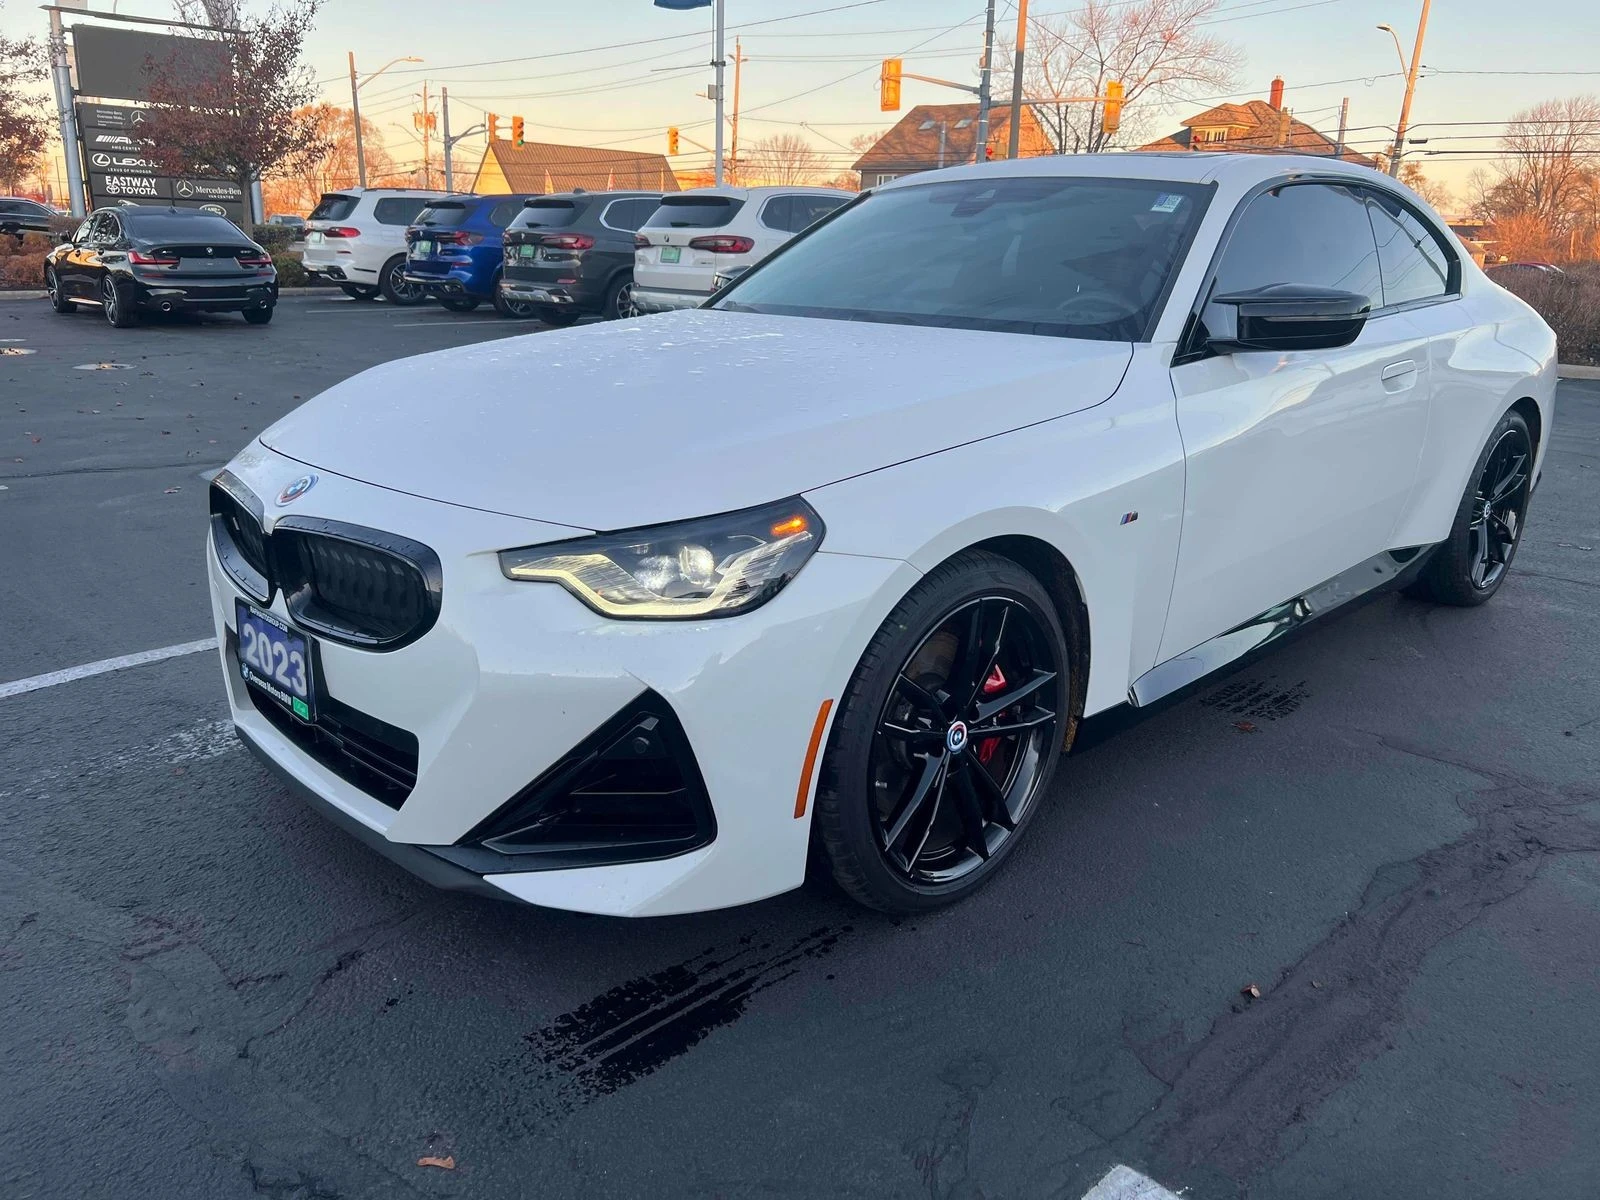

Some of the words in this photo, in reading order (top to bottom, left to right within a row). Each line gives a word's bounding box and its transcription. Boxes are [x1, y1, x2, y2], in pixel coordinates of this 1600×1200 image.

[105, 175, 157, 188] EASTWAY
[120, 186, 158, 196] TOYOTA
[195, 185, 242, 195] Mercedes-Ben
[243, 623, 307, 697] 2023
